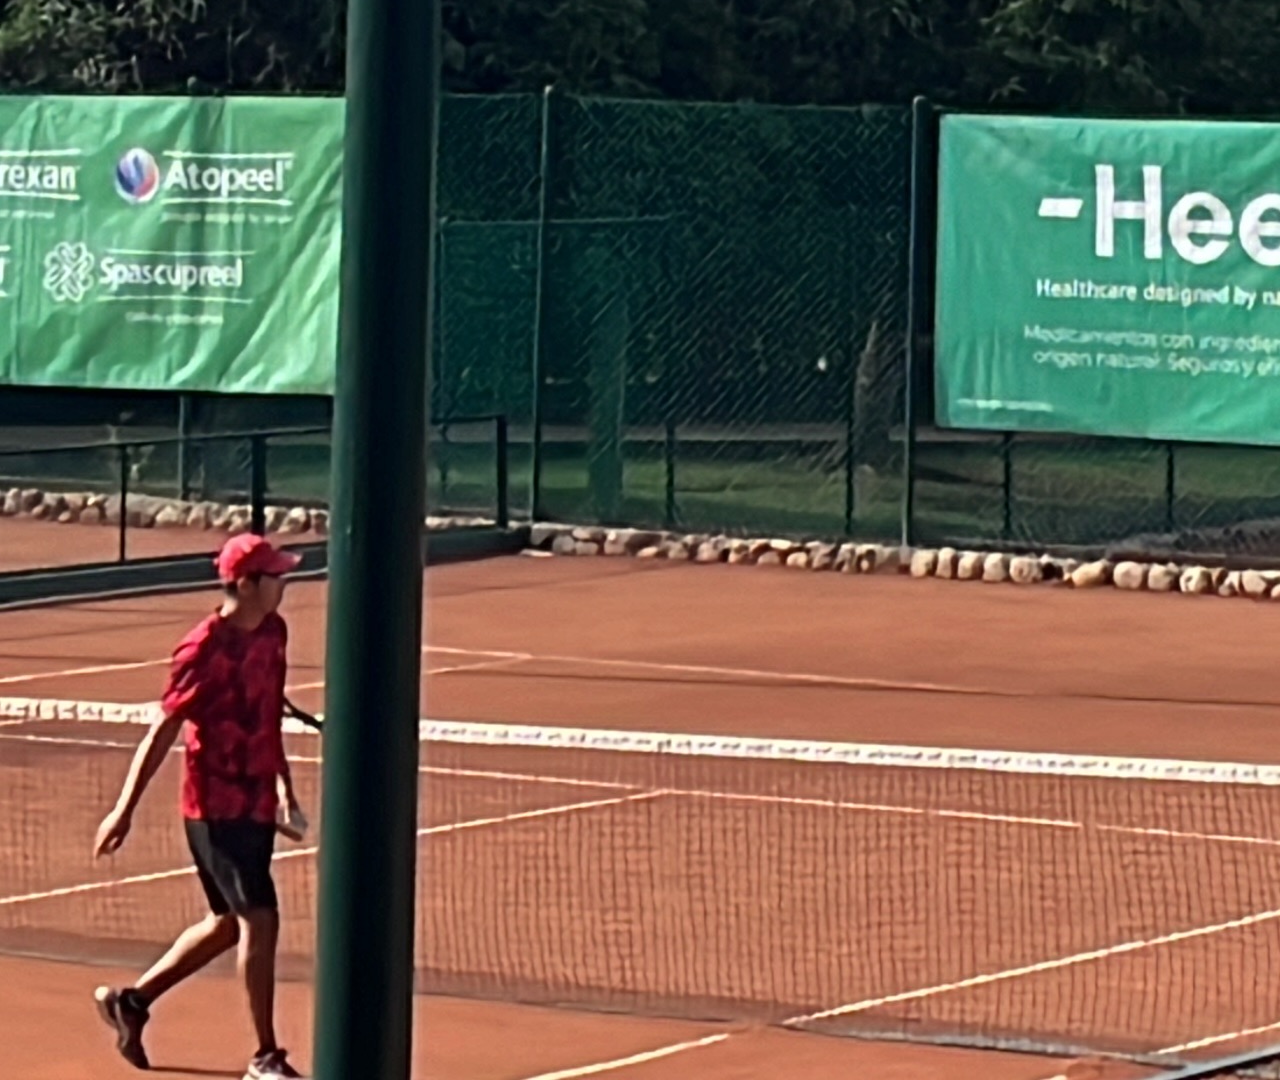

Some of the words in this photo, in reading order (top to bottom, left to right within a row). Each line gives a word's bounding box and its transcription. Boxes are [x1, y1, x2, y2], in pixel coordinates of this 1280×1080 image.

[99, 256, 243, 292] Spascupreel
[1036, 278, 1137, 300] Healthcare
[1143, 283, 1229, 307] designed
[1233, 285, 1257, 310] by
